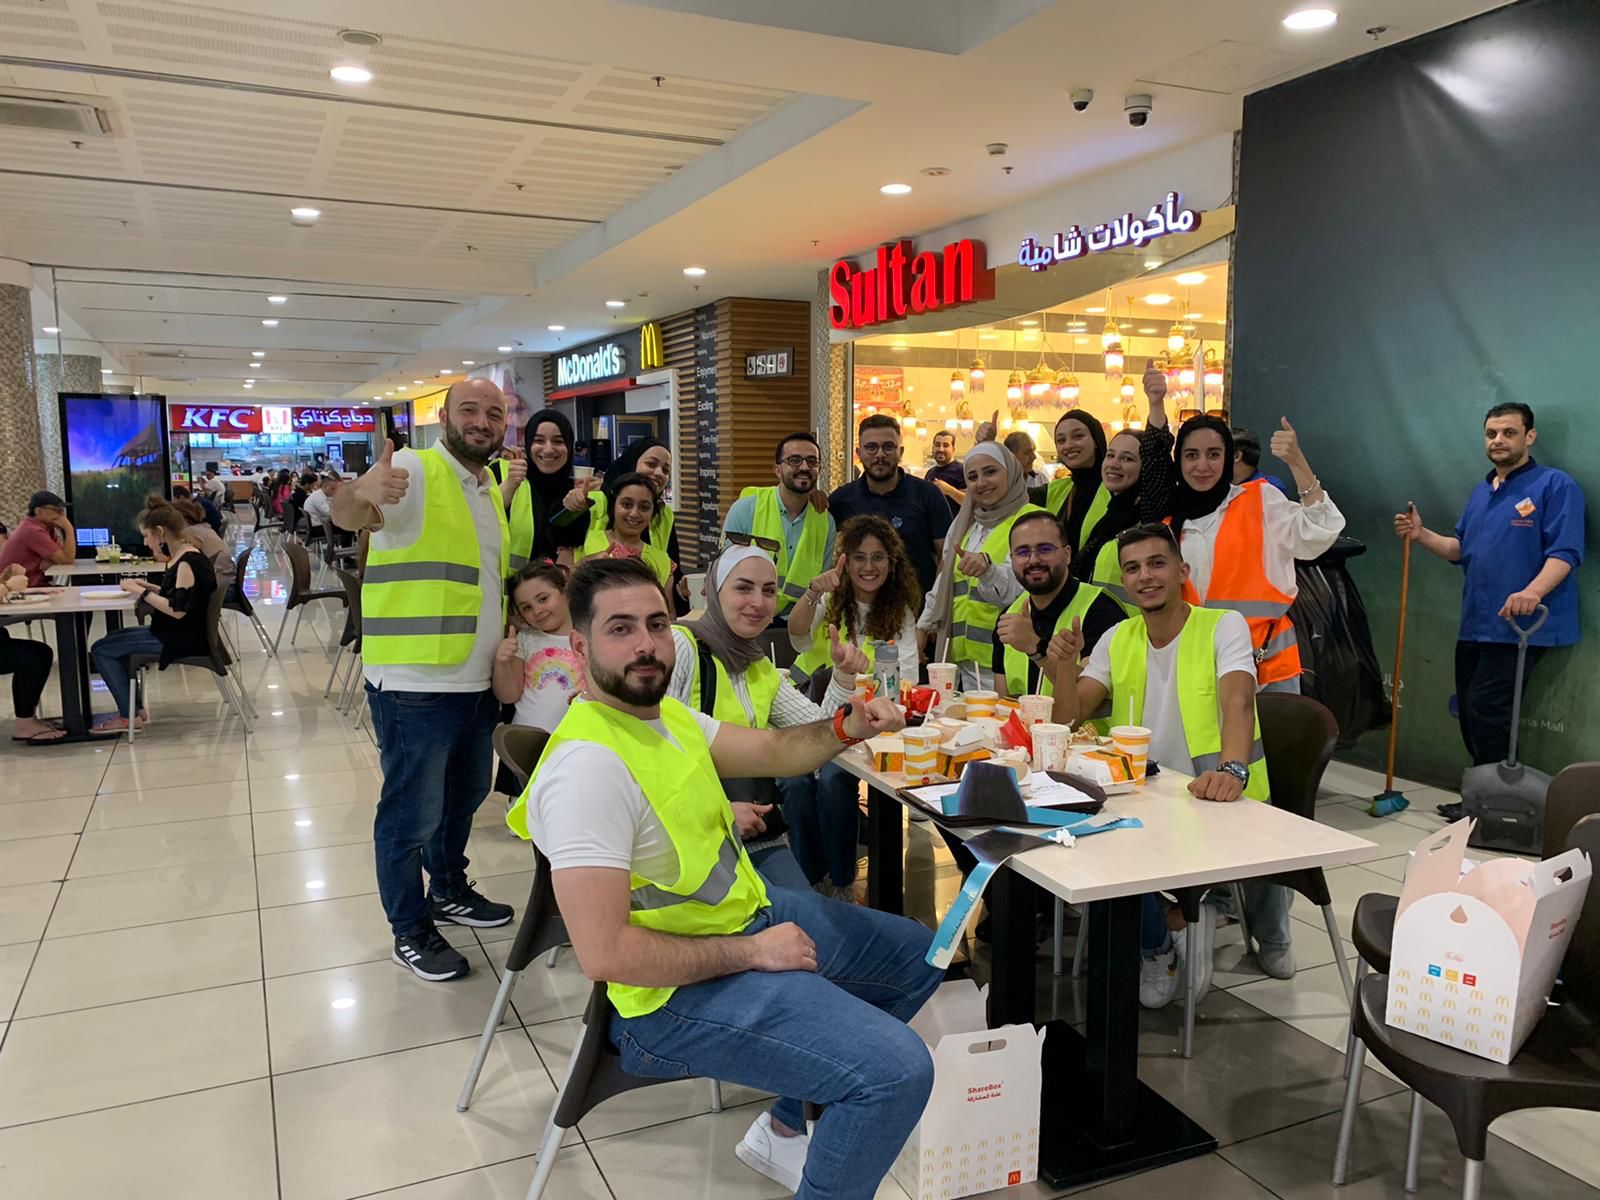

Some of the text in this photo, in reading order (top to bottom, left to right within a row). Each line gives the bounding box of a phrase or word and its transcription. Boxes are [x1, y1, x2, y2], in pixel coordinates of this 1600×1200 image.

[1018, 192, 1195, 272] مأكولات شامية
[829, 239, 977, 330] Sultan
[557, 343, 621, 387] McDonald's
[181, 407, 252, 429] KFC
[292, 410, 374, 428] دجاج كنتاكي
[967, 1083, 1002, 1094] ShareBox
